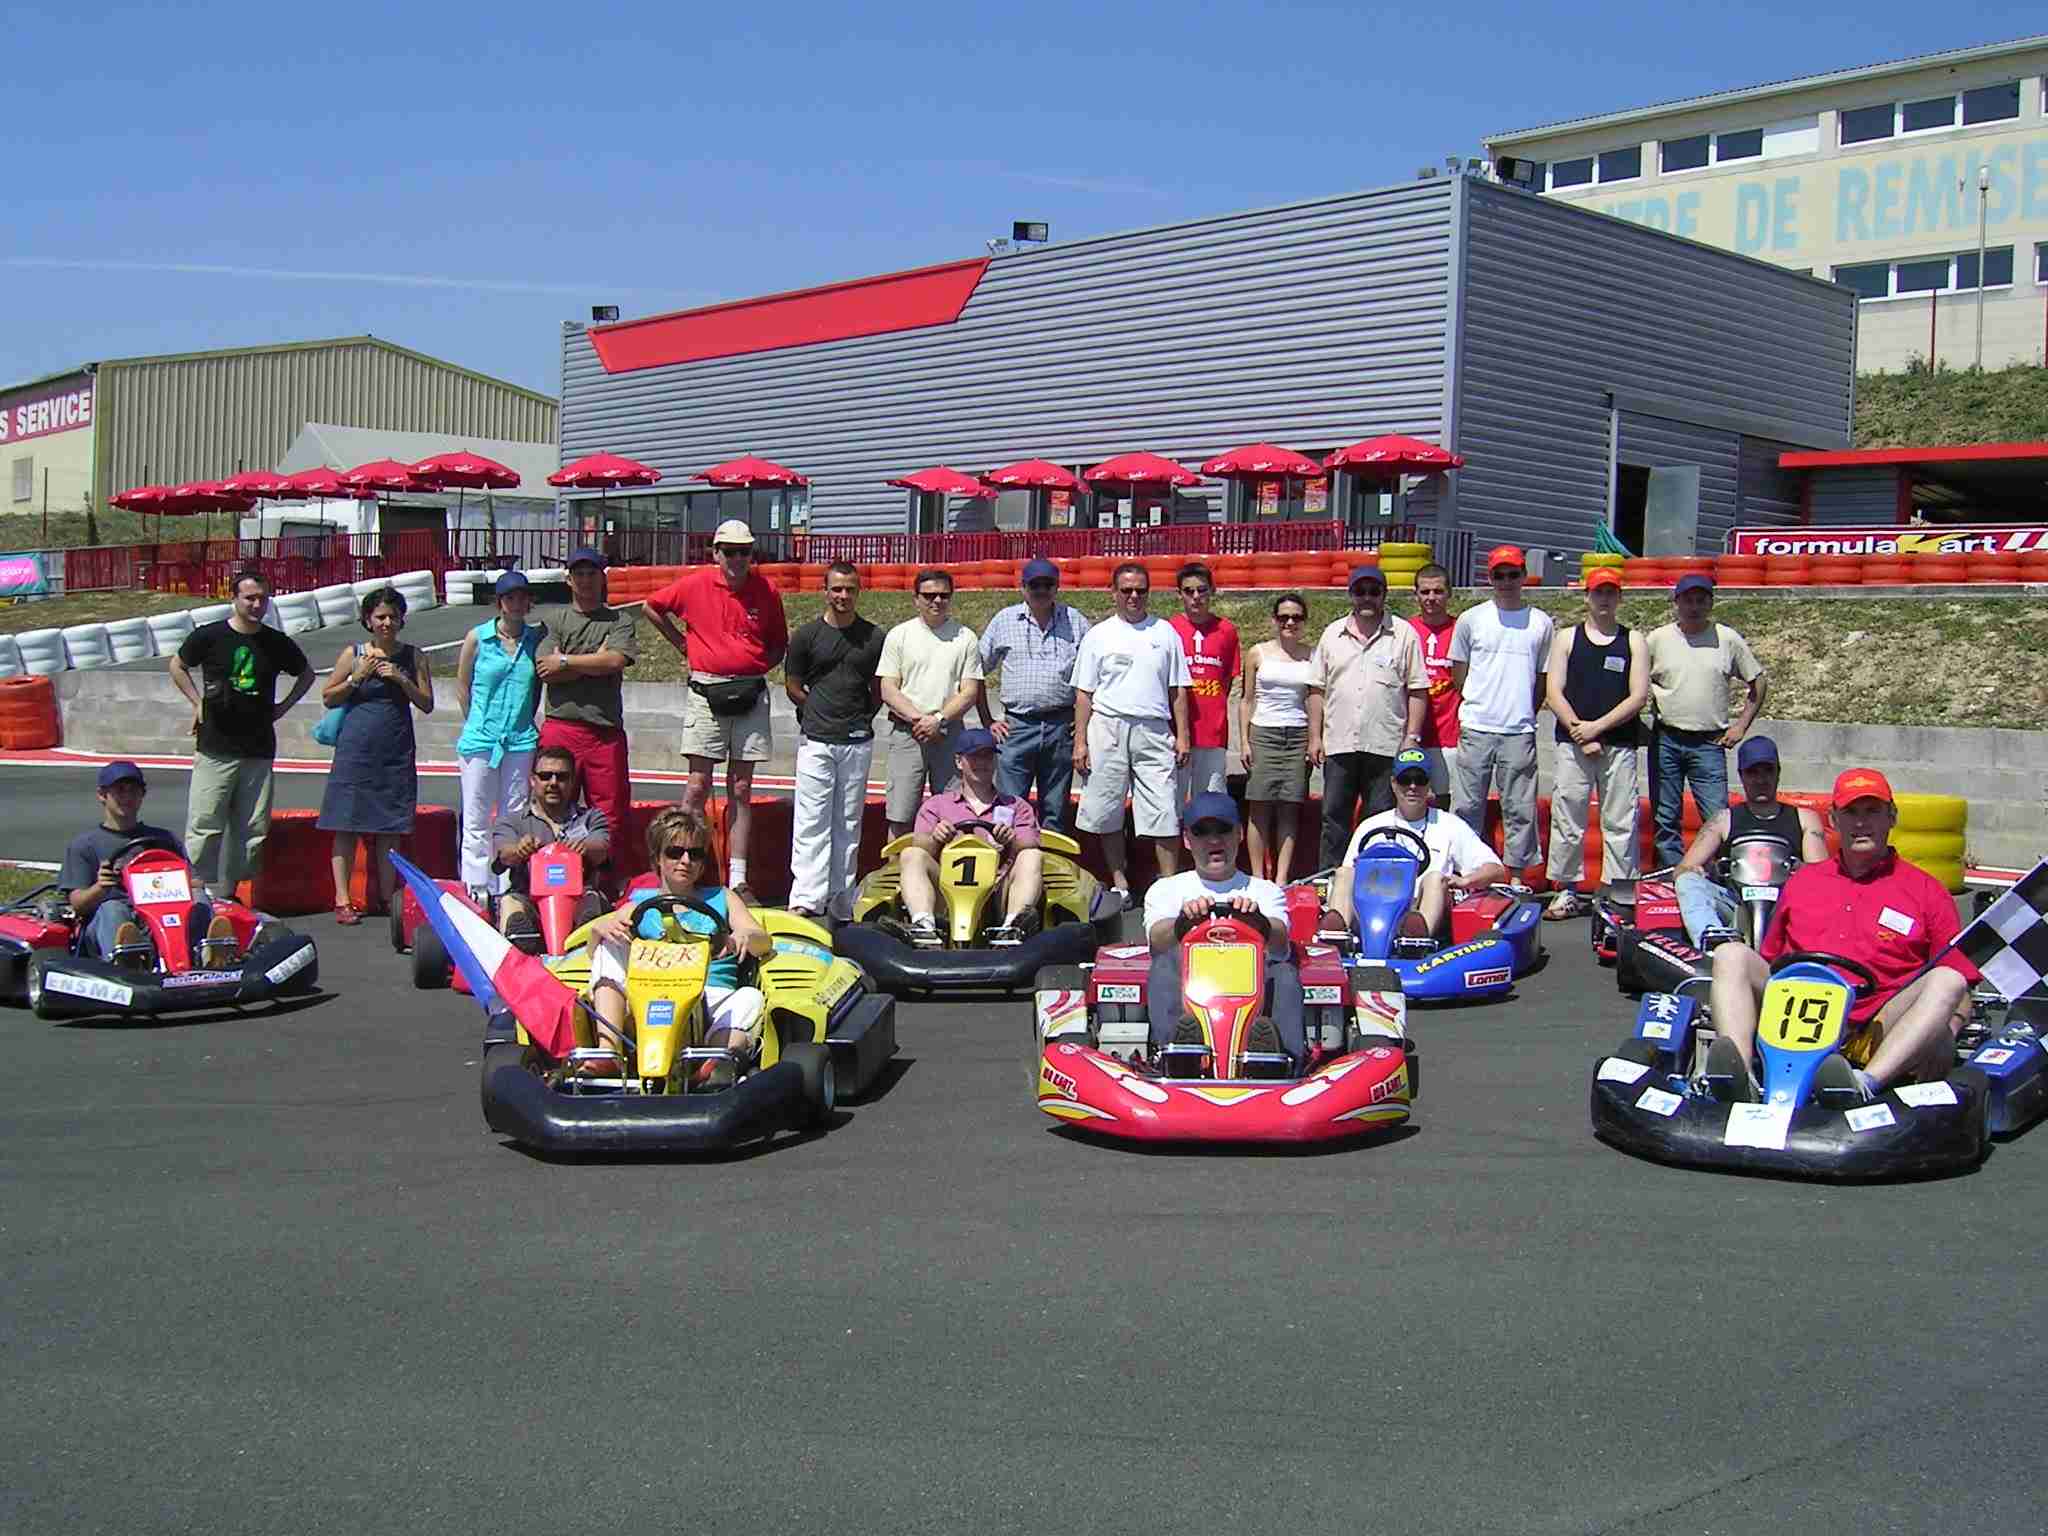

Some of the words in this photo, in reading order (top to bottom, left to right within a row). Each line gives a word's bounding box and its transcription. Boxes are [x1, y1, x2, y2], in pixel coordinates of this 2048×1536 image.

[1736, 175, 1800, 252] DE
[1837, 140, 2048, 240] REMISE
[16, 392, 91, 436] SERVICE
[951, 855, 979, 887] 1
[1415, 938, 1497, 974] KARTING
[46, 973, 128, 1002] ENSMA
[1779, 995, 1830, 1044] 19
